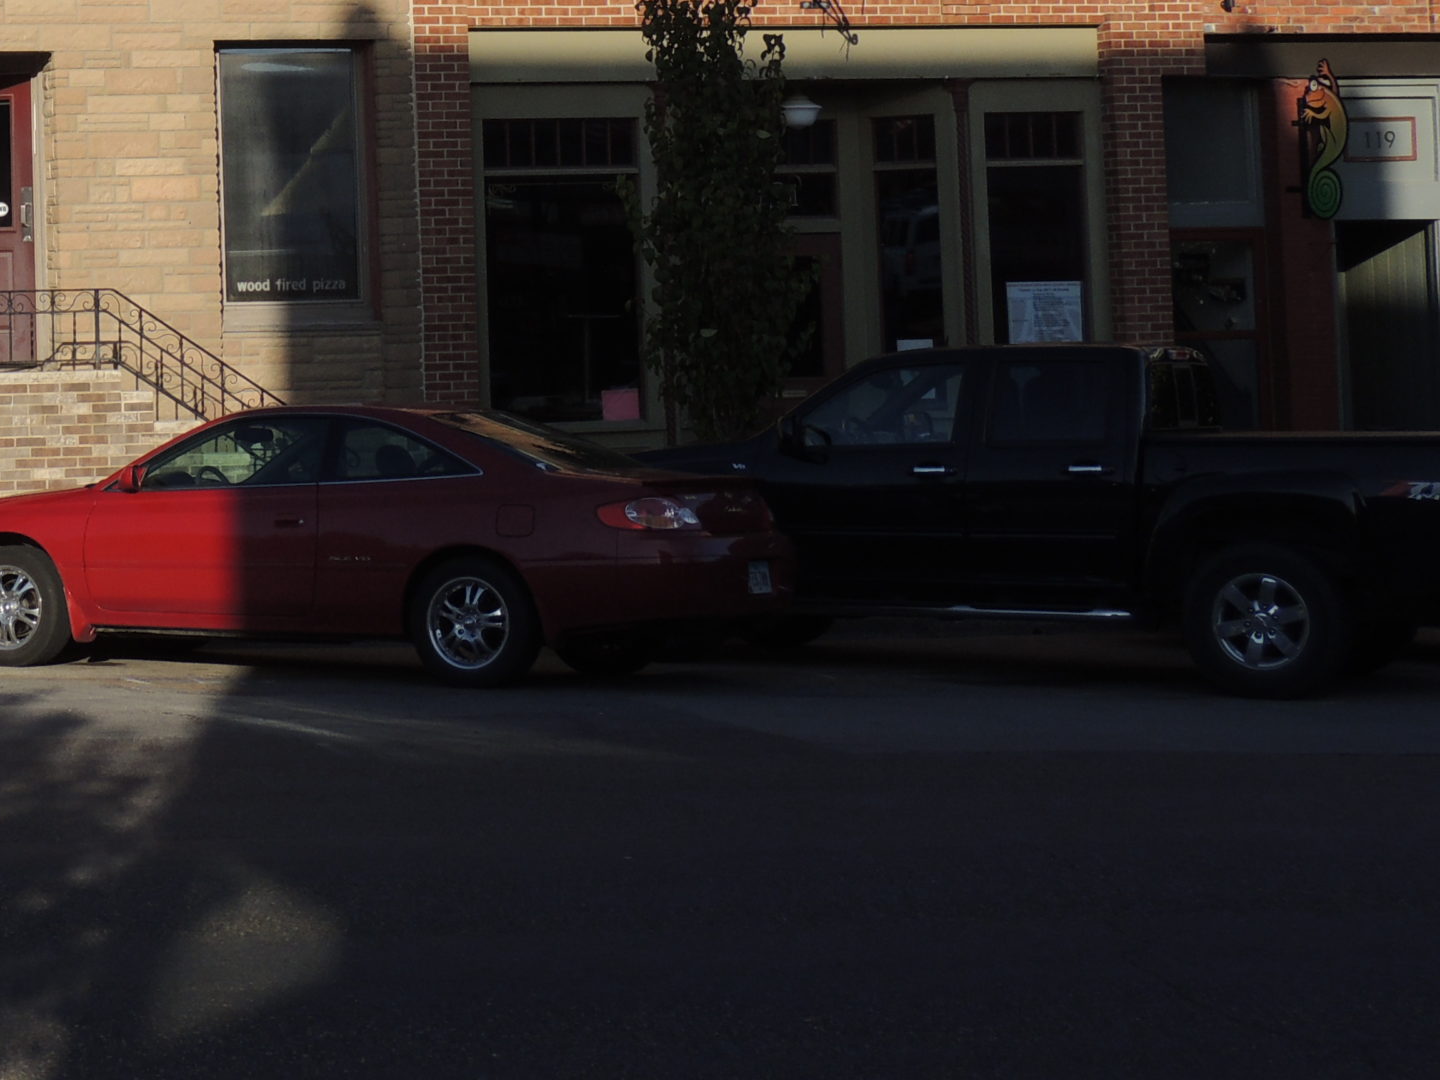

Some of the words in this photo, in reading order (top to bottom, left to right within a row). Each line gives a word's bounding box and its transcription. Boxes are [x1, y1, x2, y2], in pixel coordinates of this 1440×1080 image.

[1364, 130, 1396, 149] 119
[236, 278, 270, 293] wood
[275, 278, 306, 292] fired
[312, 278, 346, 293] pizza
